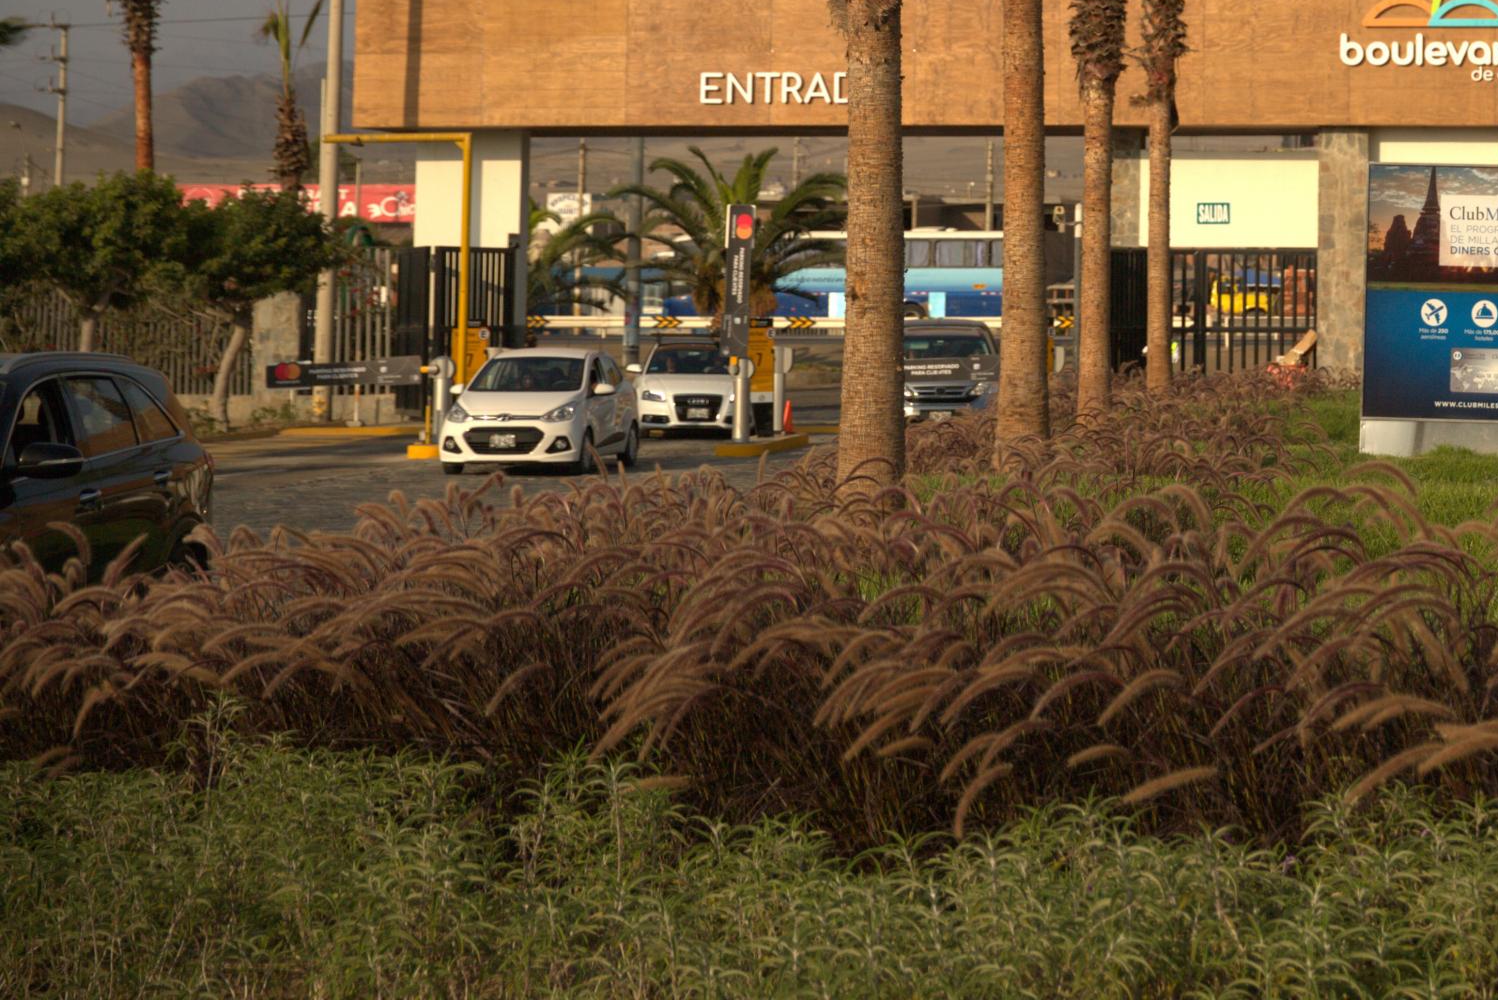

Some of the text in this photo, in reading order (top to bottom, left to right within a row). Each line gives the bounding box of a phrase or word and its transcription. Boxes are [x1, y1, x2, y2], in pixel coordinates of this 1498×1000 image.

[1470, 67, 1494, 82] de
[699, 71, 848, 104] ENTRAD
[1199, 204, 1229, 222] SALIDA
[1450, 224, 1462, 233] EL
[1450, 235, 1464, 244] DE
[1450, 246, 1490, 256] DINERS
